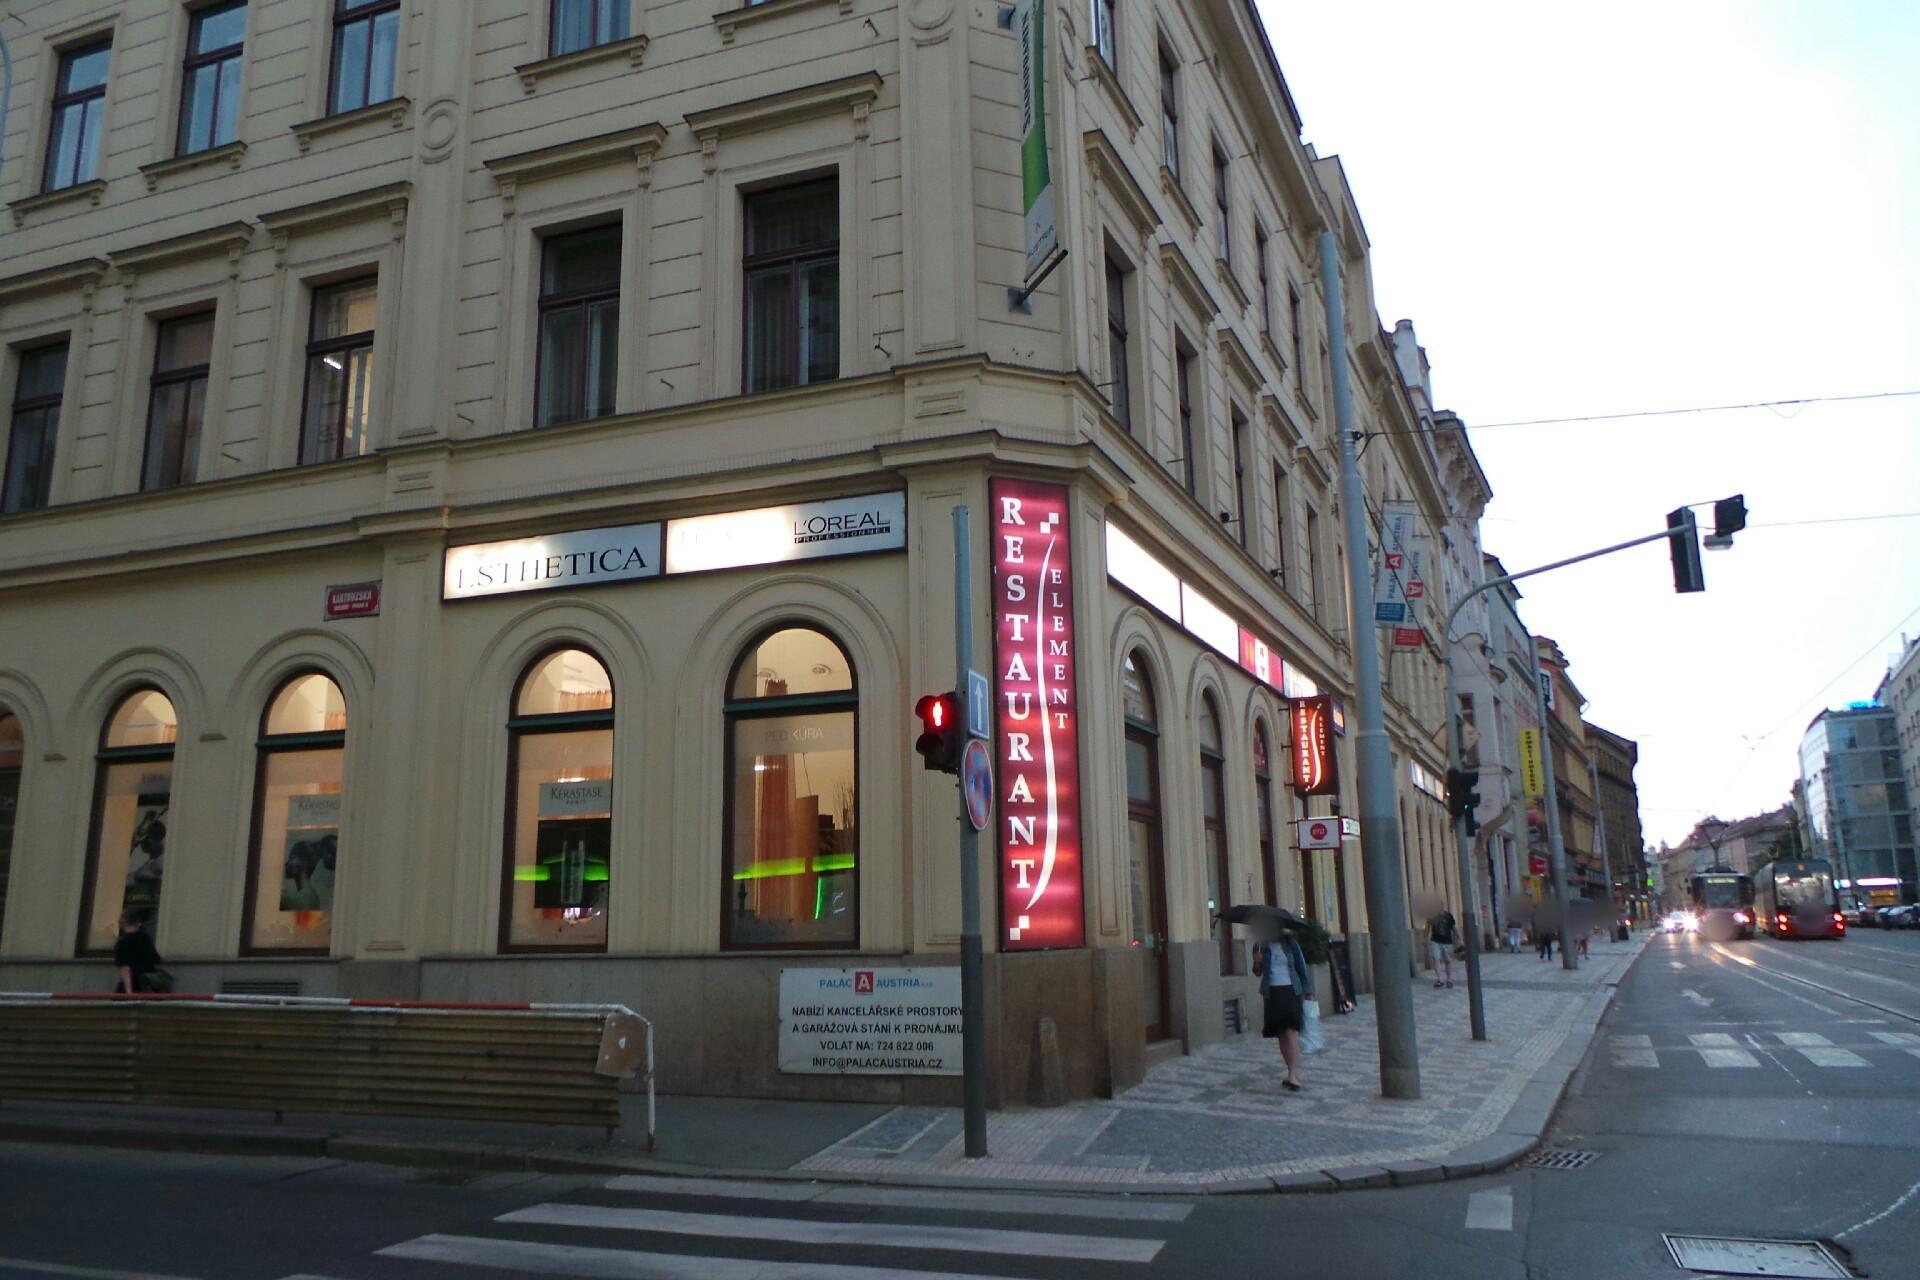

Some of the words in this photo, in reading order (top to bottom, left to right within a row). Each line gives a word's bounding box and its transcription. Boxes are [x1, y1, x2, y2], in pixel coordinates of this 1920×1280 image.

[1049, 568, 1068, 729] ELEMENT
[1000, 496, 1036, 889] RESTAURANT
[876, 977, 920, 988] AUSTRIA
[792, 1004, 825, 1017] NABÍZÍ
[828, 1004, 903, 1017] KANCELÁŘSKÉ
[792, 1023, 799, 1033] A
[801, 1021, 858, 1034] GARÁŽOVÁ
[860, 1021, 891, 1034] STÁNÍ
[895, 1023, 901, 1034] K
[820, 1040, 853, 1051] VOLAT
[856, 1040, 874, 1051] NA:
[877, 1040, 893, 1051] 724
